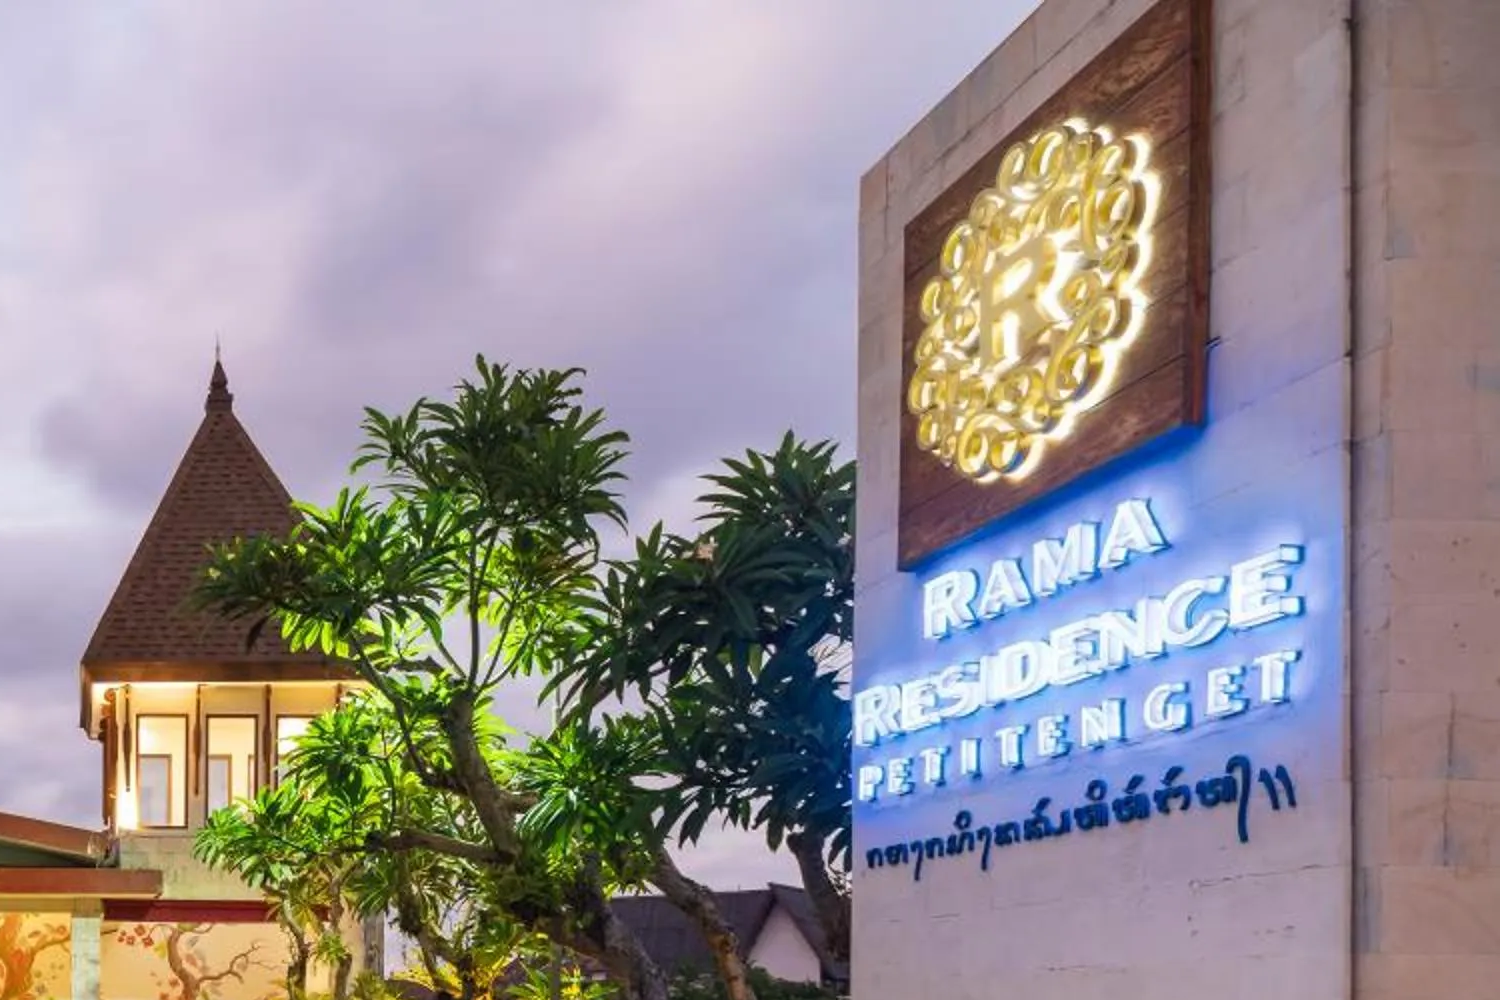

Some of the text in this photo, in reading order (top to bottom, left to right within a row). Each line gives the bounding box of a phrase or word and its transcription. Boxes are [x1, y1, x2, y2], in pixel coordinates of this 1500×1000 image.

[924, 498, 1169, 638] RAMA
[854, 543, 1305, 748] RESIDENCE
[858, 650, 1303, 802] PETITENGET
